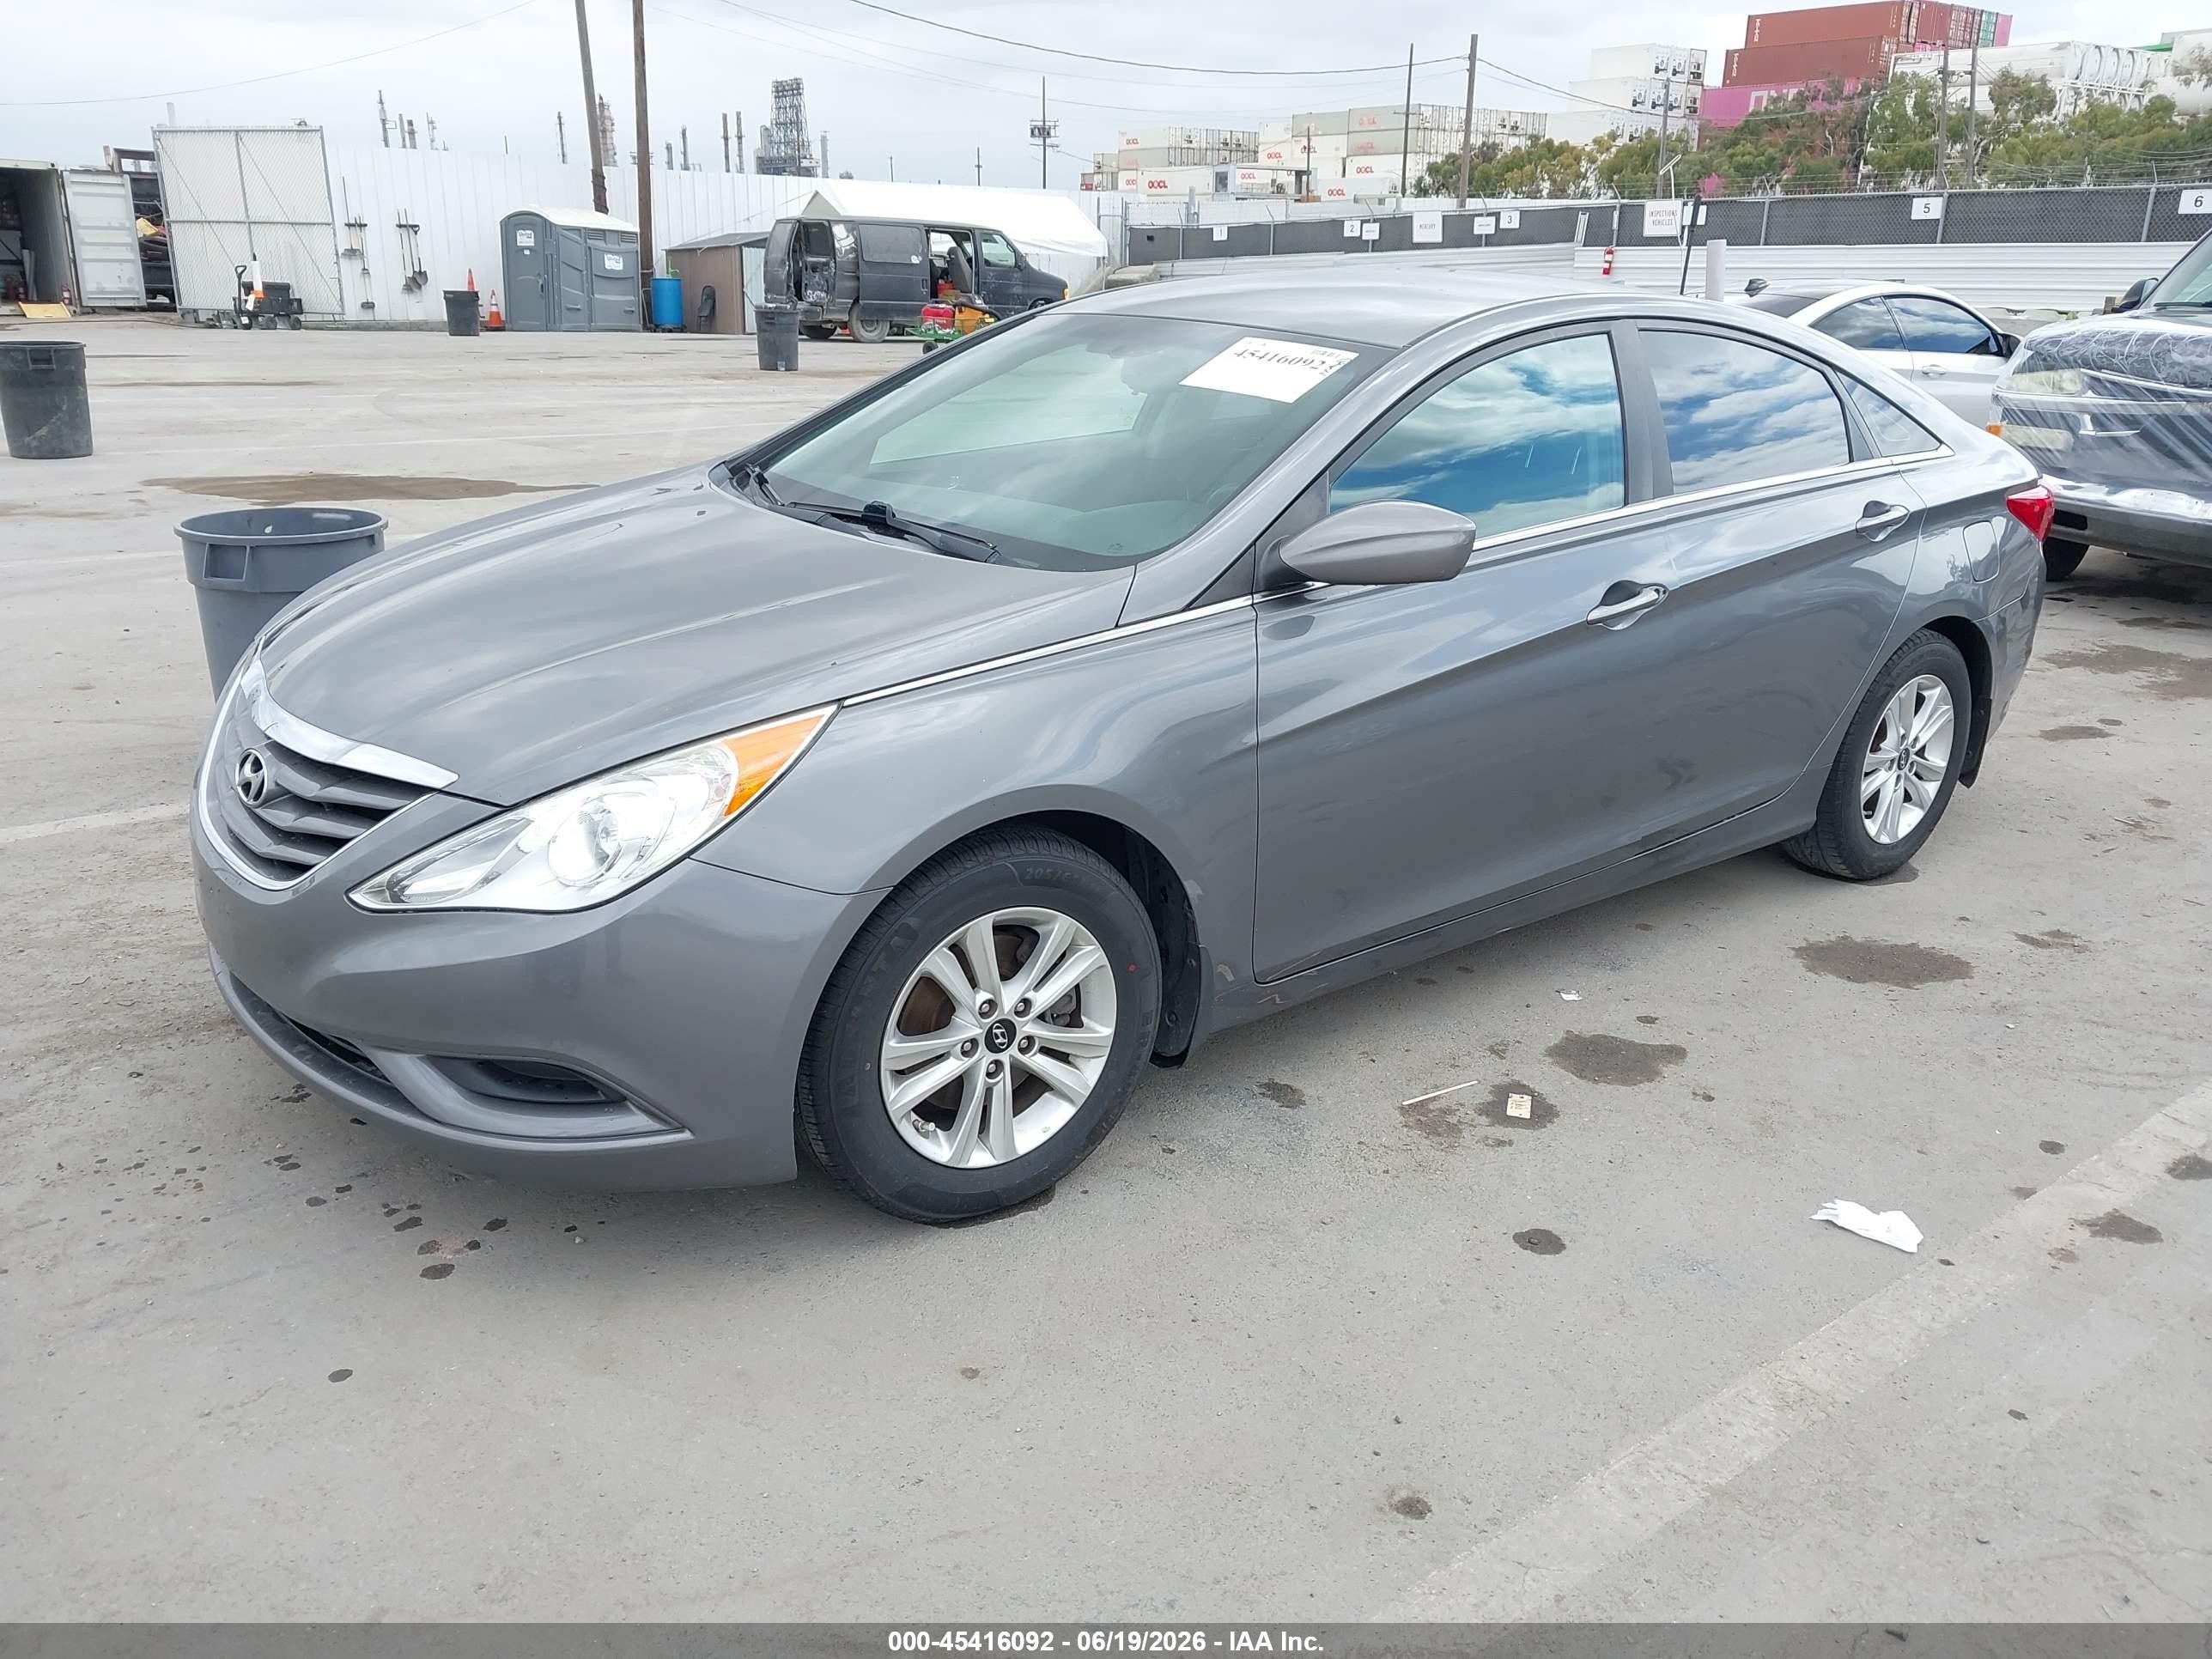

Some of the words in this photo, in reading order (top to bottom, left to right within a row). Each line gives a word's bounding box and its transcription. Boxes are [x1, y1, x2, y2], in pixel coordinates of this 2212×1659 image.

[1300, 145, 1318, 154] OCL
[1267, 151, 1283, 160] OOCL
[1356, 166, 1374, 174] OOCL
[1147, 179, 1169, 190] OOCL
[1328, 188, 1346, 197] OOCL
[2193, 195, 2204, 208] 6
[1923, 203, 1931, 214] 5
[1507, 215, 1513, 224] 3
[1350, 224, 1355, 233] 2
[1233, 348, 1327, 369] 45416092
